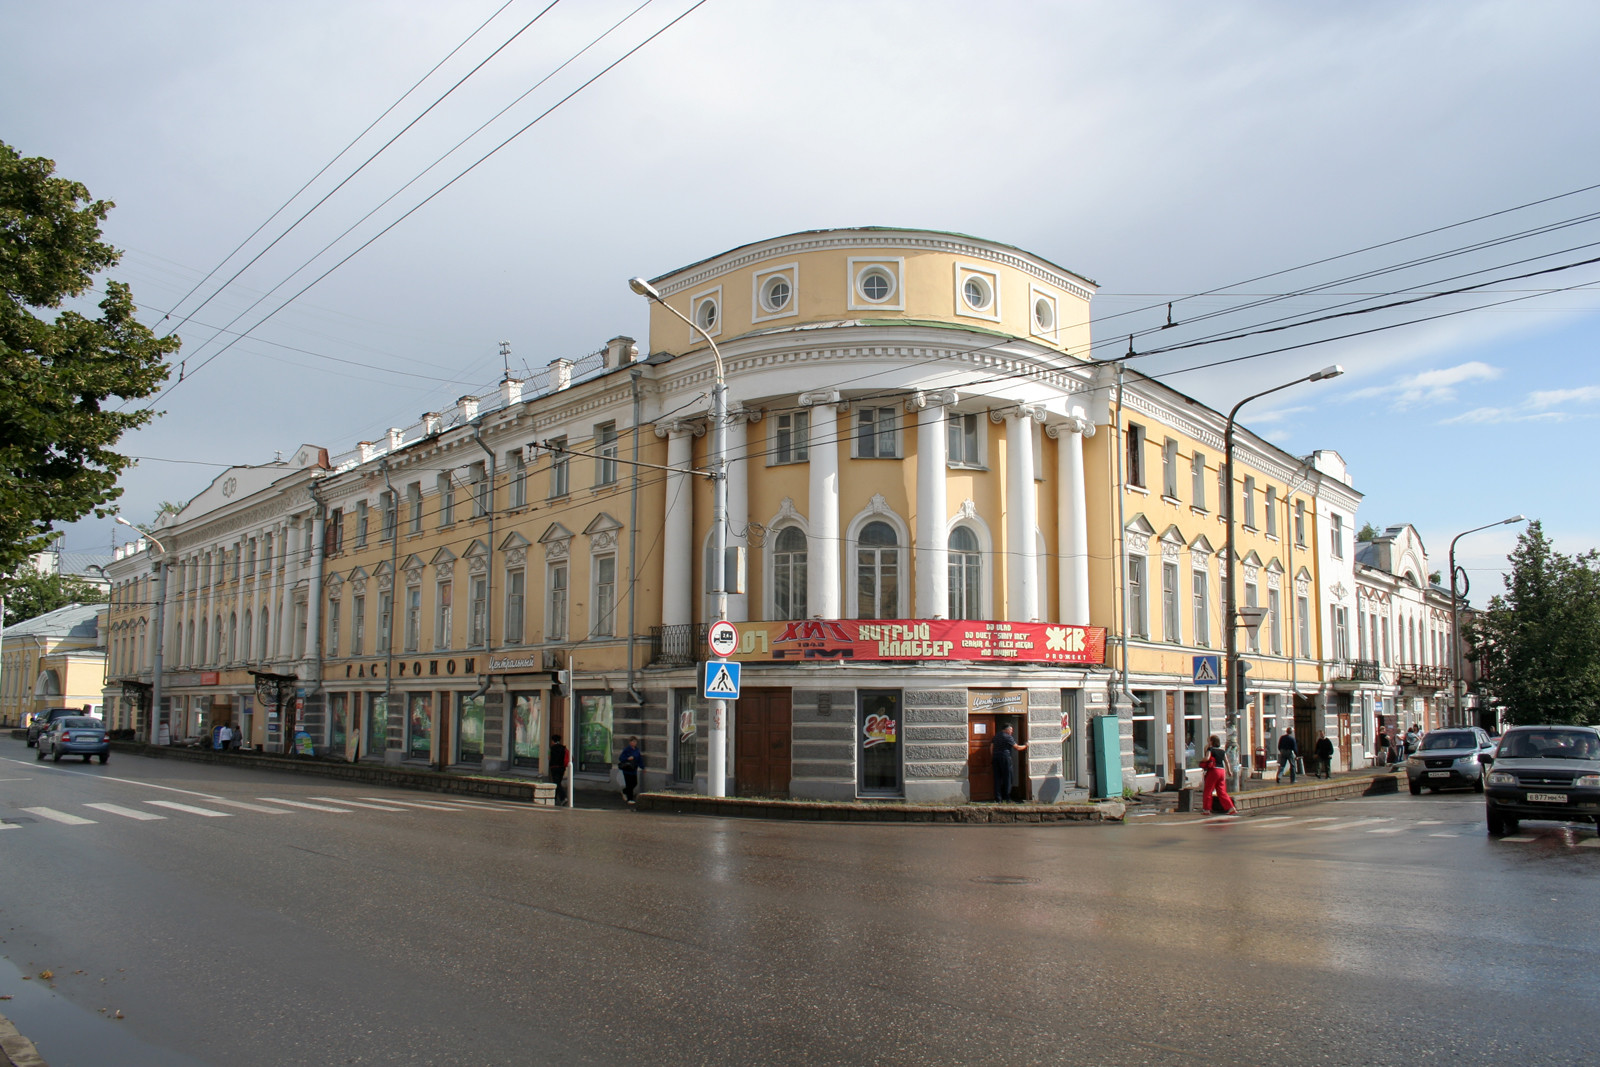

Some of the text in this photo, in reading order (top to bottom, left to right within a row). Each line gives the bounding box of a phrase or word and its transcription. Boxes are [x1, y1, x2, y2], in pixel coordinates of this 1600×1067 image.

[773, 621, 854, 644] ХИТ
[858, 622, 930, 641] ХИТРЫЙ
[878, 640, 954, 657] КЛАББЕР
